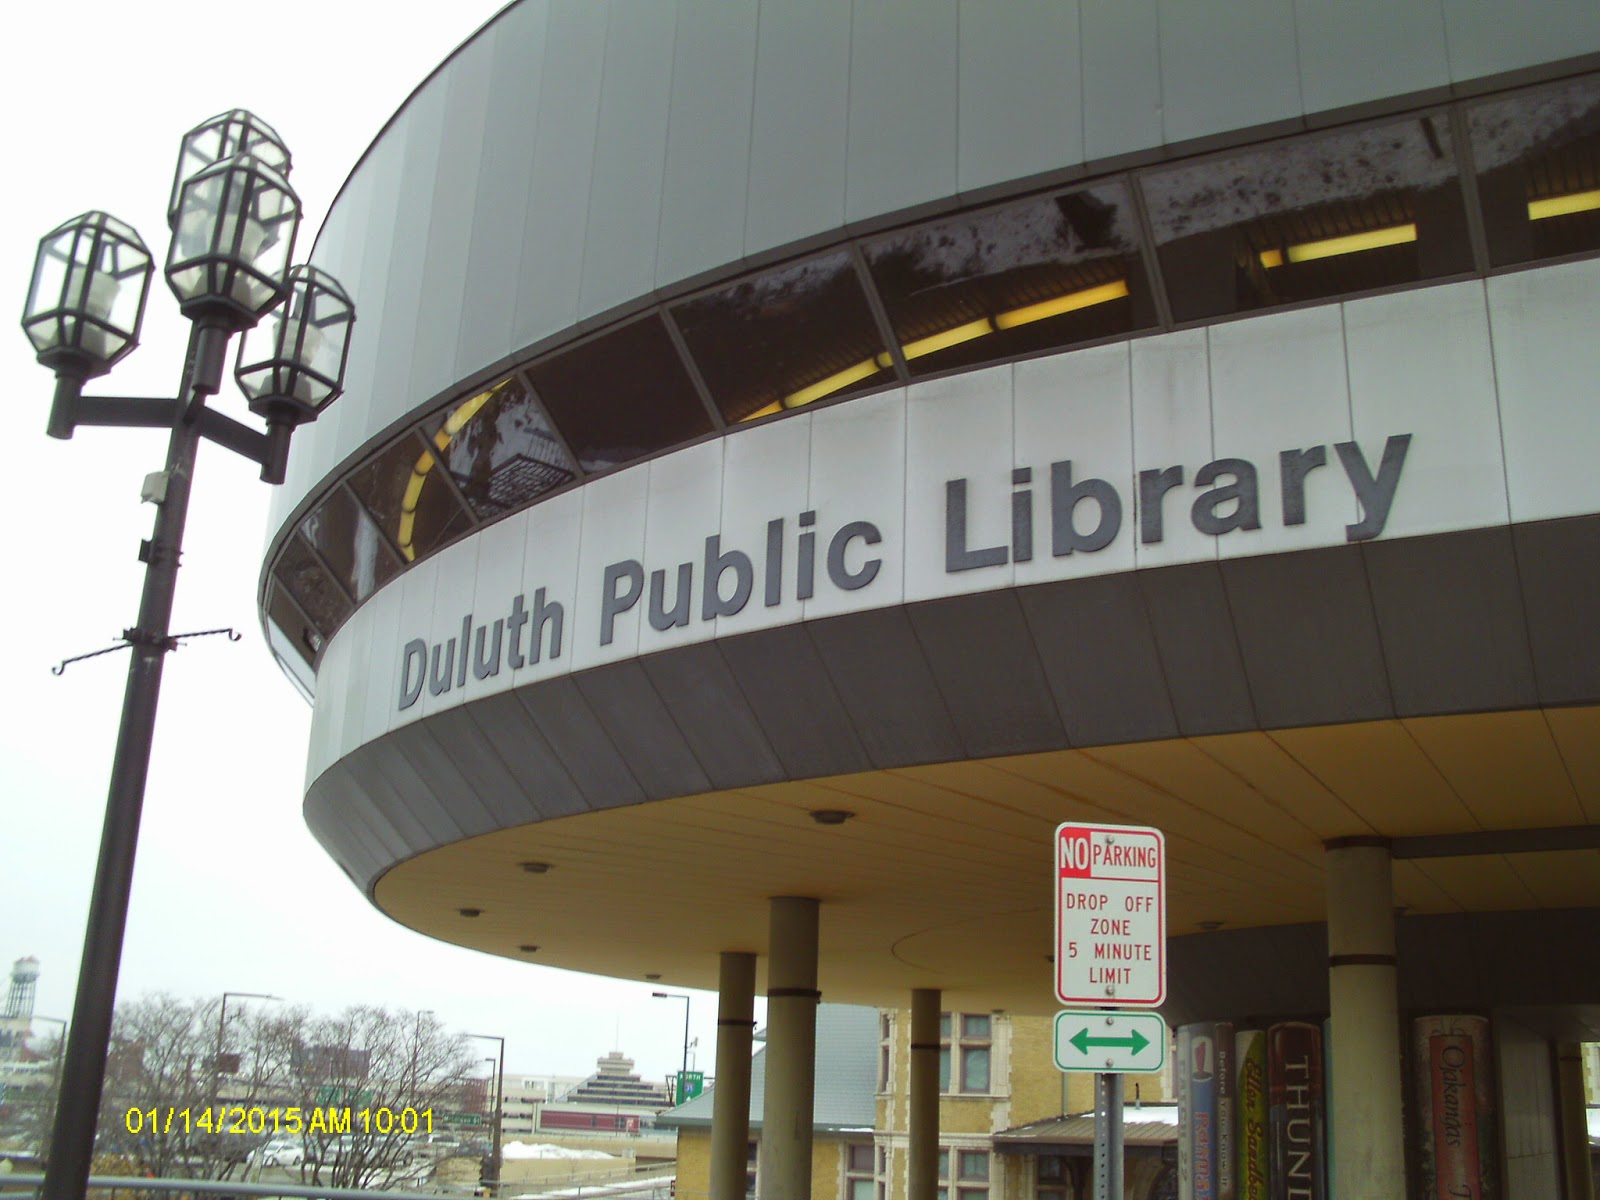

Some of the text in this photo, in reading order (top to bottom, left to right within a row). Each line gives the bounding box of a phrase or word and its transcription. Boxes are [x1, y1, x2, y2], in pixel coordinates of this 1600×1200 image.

[398, 433, 1413, 711] Duluth Public Library
[1060, 837, 1157, 870] NO PARKING
[1066, 893, 1154, 913] DROP OFF
[1090, 918, 1131, 936] ZONE
[1069, 942, 1152, 961] 5 MINUTE
[1089, 967, 1132, 985] LIMIT
[1247, 1058, 1263, 1110] Ellen
[1440, 1046, 1466, 1147] Ojakangas
[1219, 1101, 1227, 1127] You
[1220, 1134, 1228, 1169] Know
